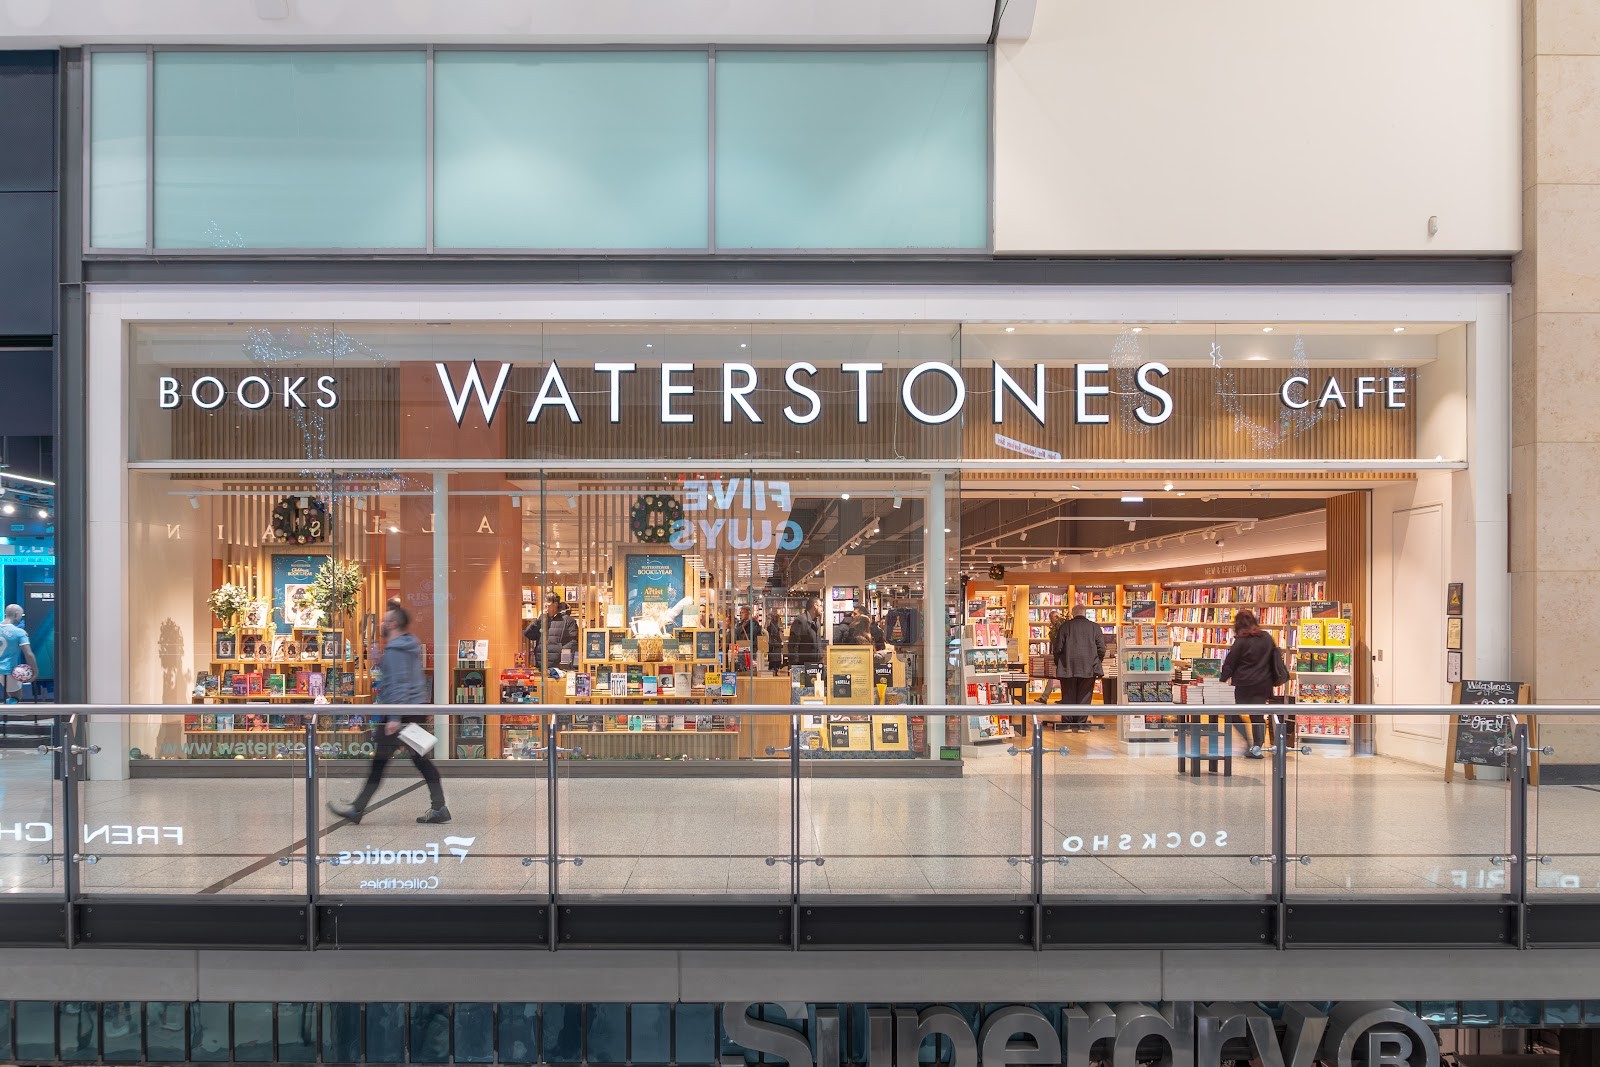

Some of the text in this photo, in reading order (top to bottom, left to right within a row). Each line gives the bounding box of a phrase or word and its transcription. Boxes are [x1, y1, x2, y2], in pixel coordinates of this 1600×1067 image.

[159, 375, 339, 409] BOOKS
[435, 358, 1173, 428] WATERSTONES
[1280, 375, 1406, 409] CAFE
[161, 739, 377, 755] www.waterstoes.co
